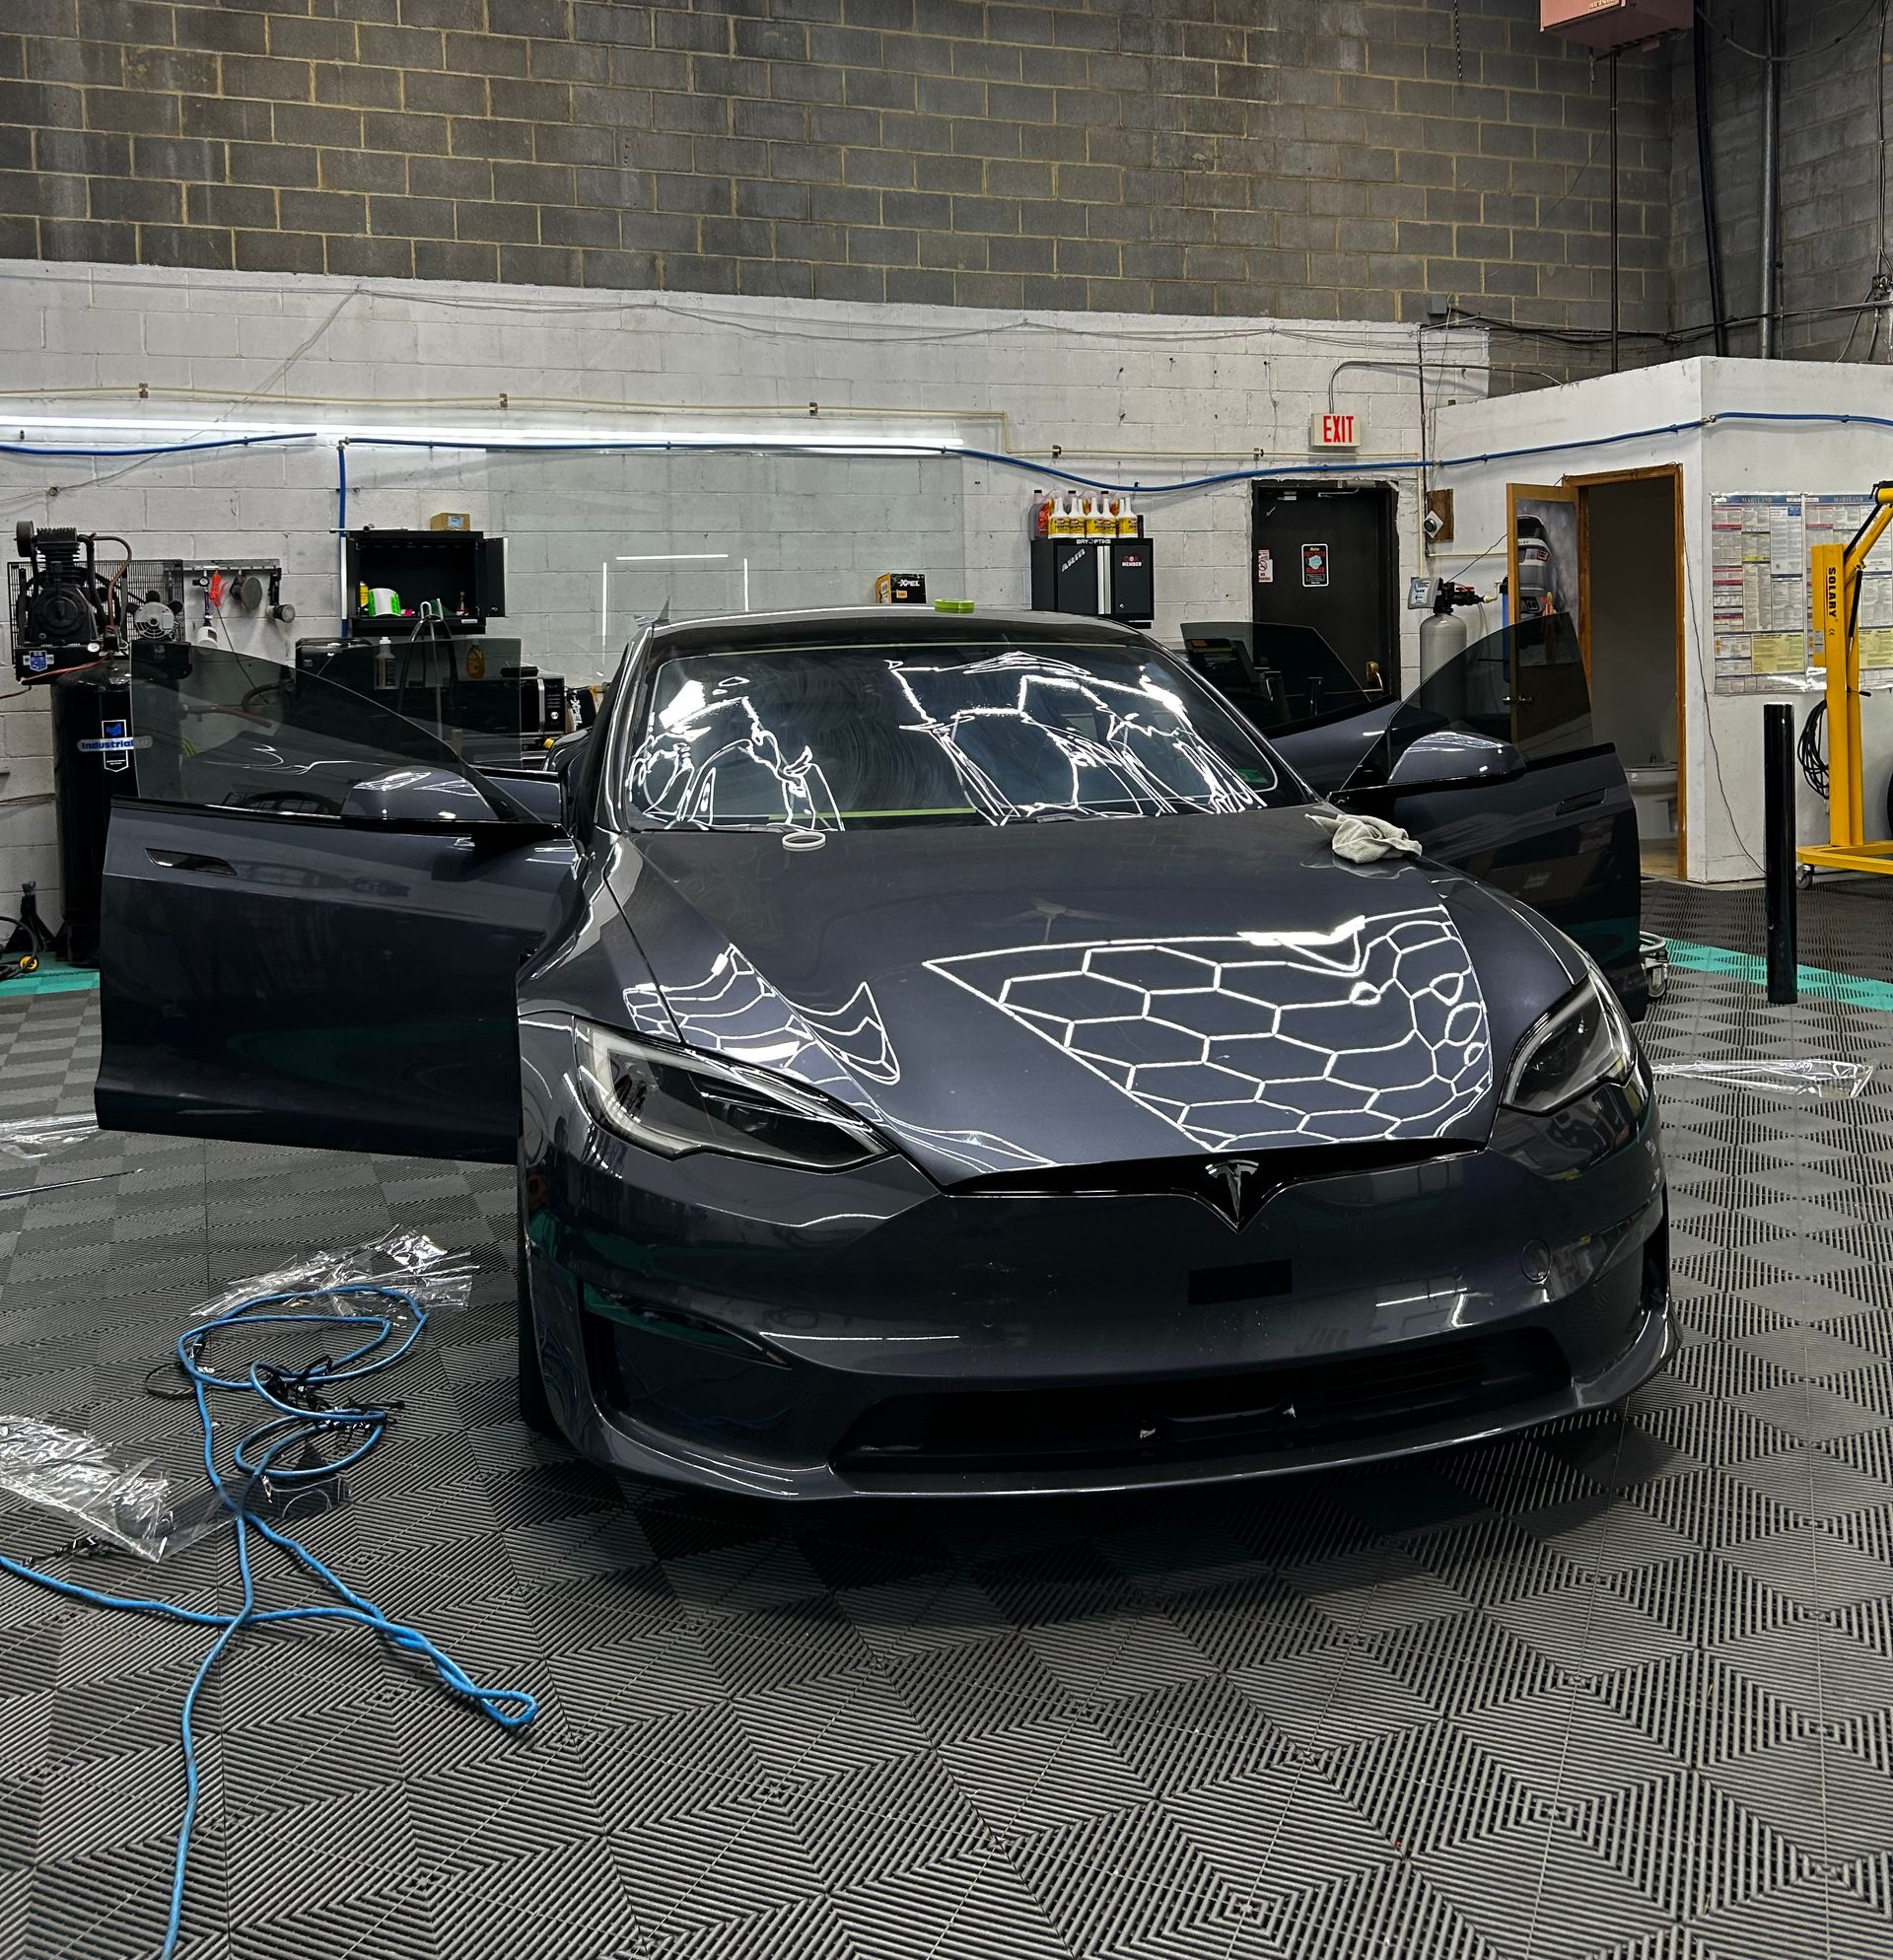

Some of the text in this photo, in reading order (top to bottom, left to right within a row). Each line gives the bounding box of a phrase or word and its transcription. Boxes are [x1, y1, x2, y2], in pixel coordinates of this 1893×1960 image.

[1323, 415, 1354, 443] EXIT
[1828, 567, 1837, 618] SOLARY
[570, 699, 583, 724] XPEL
